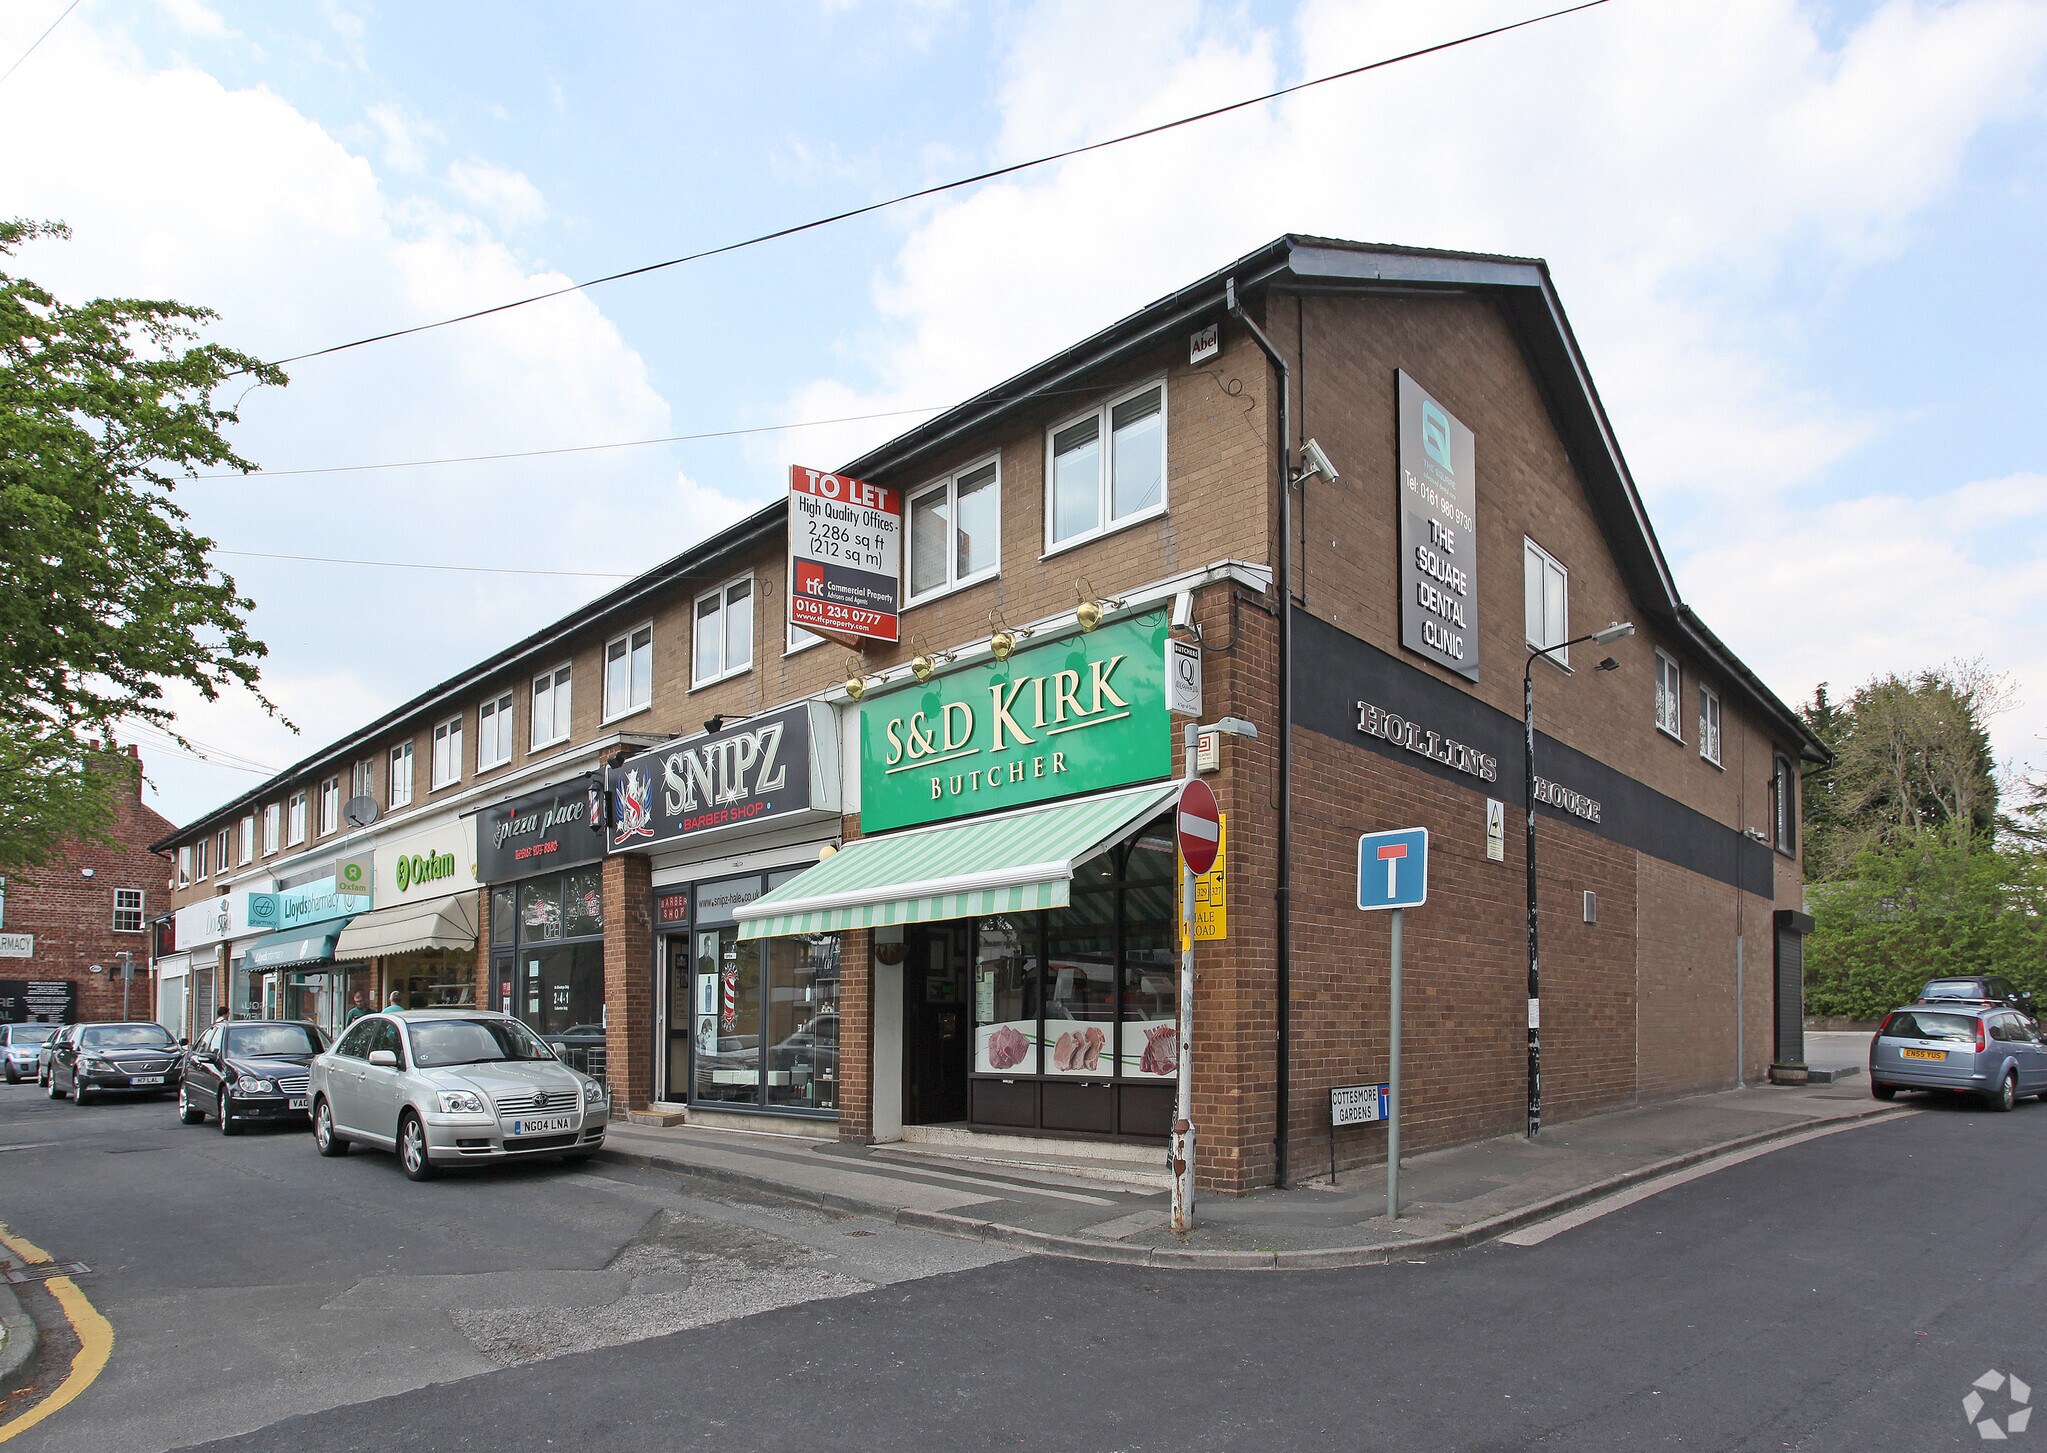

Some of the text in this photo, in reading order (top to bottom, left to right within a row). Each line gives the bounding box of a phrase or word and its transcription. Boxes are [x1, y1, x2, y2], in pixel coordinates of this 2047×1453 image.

[1192, 331, 1217, 355] Abel
[806, 469, 888, 510] TO LET
[1404, 469, 1473, 533] Tel: 0161 980 9730
[799, 495, 894, 532] High Quality Offices
[808, 520, 885, 551] 2,286 sq ft
[1431, 517, 1455, 555] THE
[810, 537, 883, 570] (212 sq m)
[1417, 545, 1467, 597] SQUARE
[806, 577, 824, 597] tfc
[827, 581, 894, 604] Commercial Property
[796, 599, 881, 626] 0161 234 0777
[845, 595, 854, 603] and
[854, 597, 868, 606] Agents
[1419, 580, 1467, 629] DENTAL
[796, 612, 870, 632] www.tfcproperty.com
[1175, 644, 1198, 658] BUTCHERS
[1424, 620, 1464, 660] CLINIC
[1180, 658, 1194, 686] Q
[885, 655, 1129, 766] S&D KIRK
[664, 720, 787, 817] SNIPZ
[1357, 700, 1601, 824] HOLLINS HOUSE
[931, 752, 1068, 800] BUTCHER
[496, 796, 584, 850] pizza place
[683, 801, 764, 831] BARBER SHOP
[411, 848, 455, 884] Oxfam
[339, 882, 366, 892] Oxfam
[698, 889, 760, 908] www.snipz-hale.co.uk
[1197, 886, 1222, 897] 329 327
[284, 892, 340, 922] Lloydspharmacy
[660, 896, 687, 908] BARBER
[663, 907, 686, 920] SHOP
[250, 918, 278, 927] pharmacy
[1183, 921, 1189, 935] 1
[1194, 925, 1216, 936] OAD
[0, 937, 31, 951] RMACY
[1905, 1050, 1941, 1060] EN55 YUS
[1332, 1088, 1377, 1106] COTTESMORE
[524, 1118, 569, 1132] NG04 LNA
[1339, 1106, 1372, 1122] GARDENS
